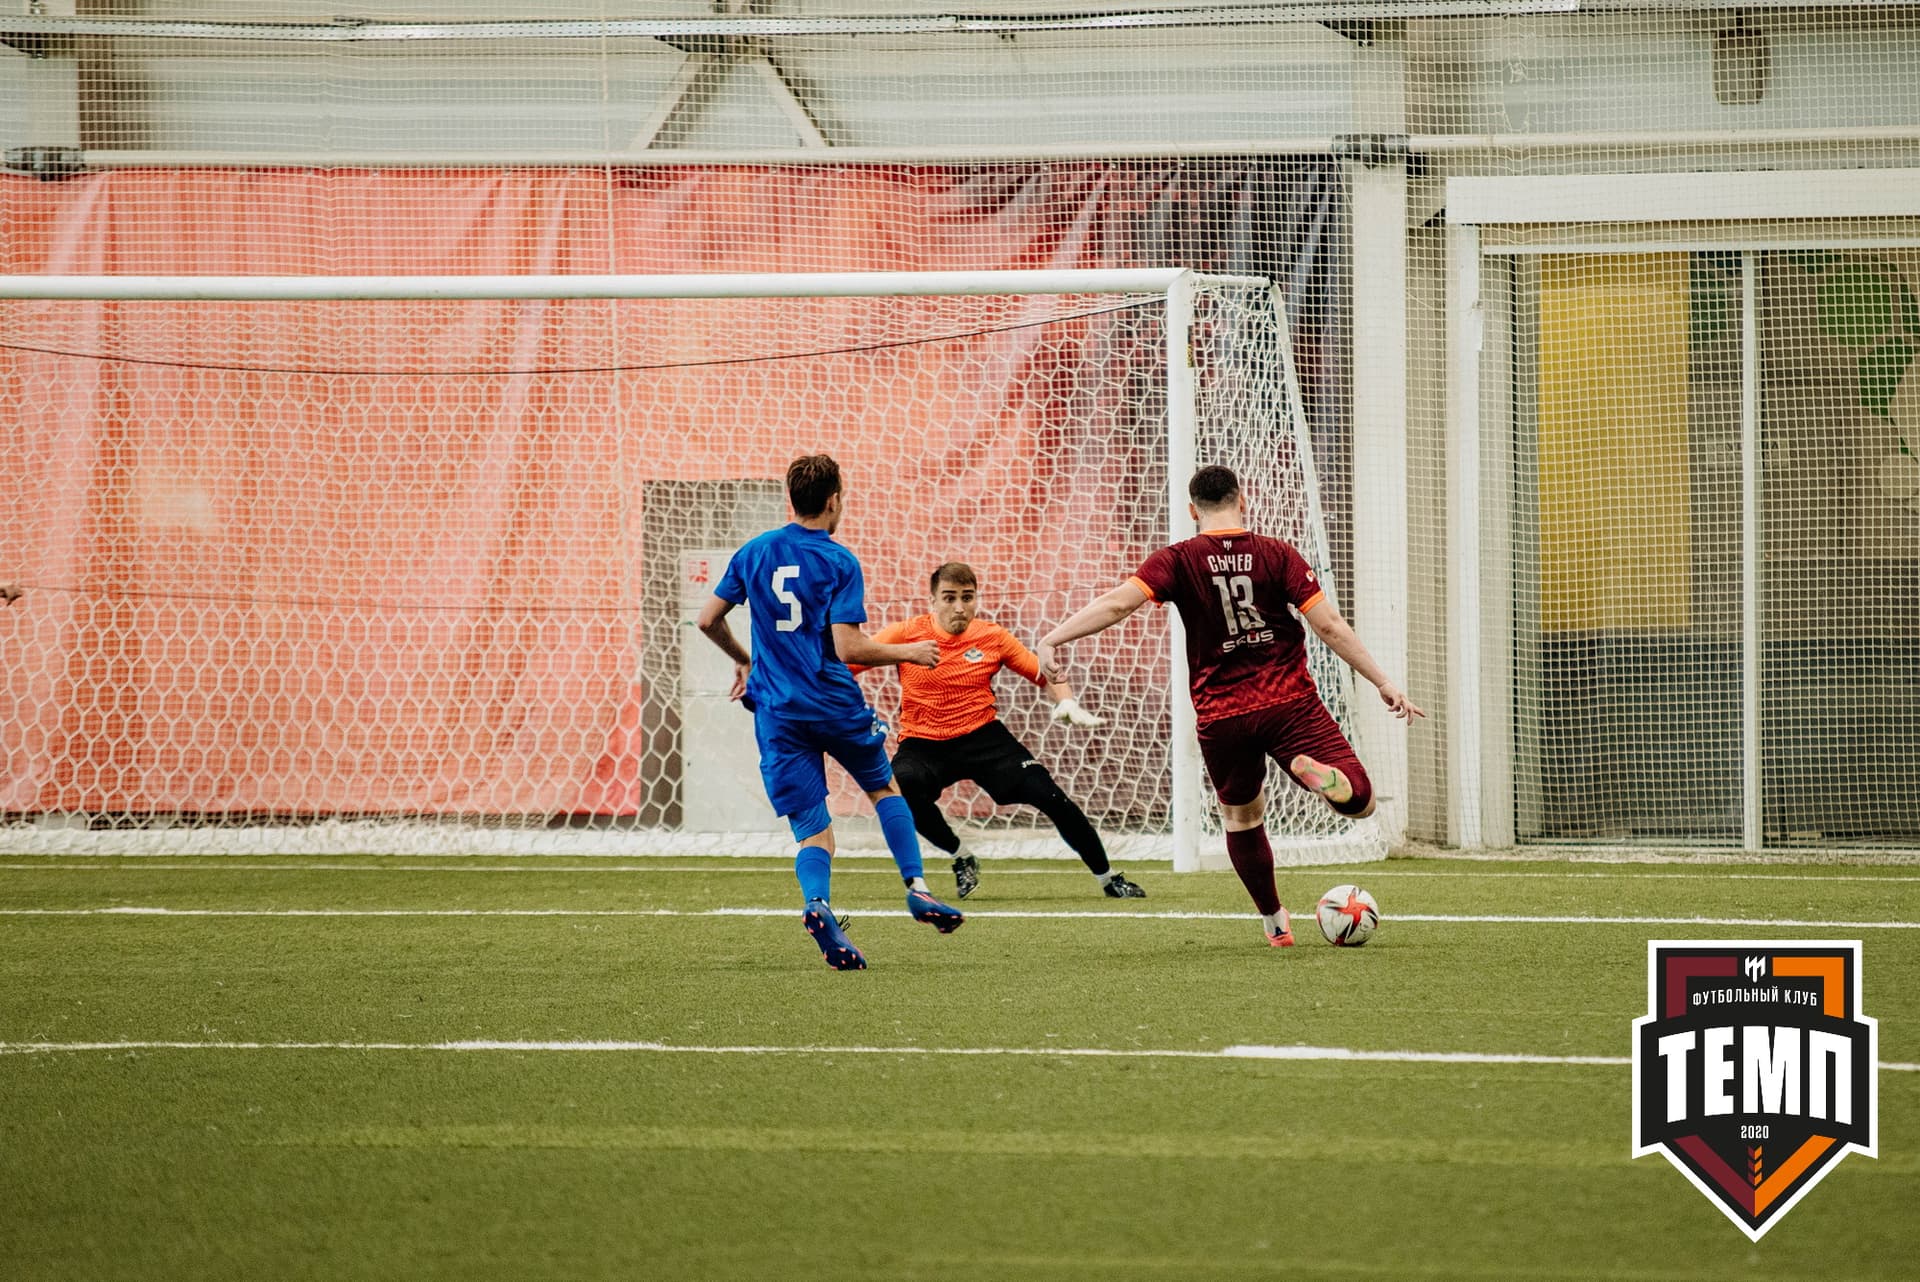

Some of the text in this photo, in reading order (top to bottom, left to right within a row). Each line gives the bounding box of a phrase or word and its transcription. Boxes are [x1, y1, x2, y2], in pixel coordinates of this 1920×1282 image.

[1207, 553, 1253, 573] СЫЧЕВ
[771, 565, 804, 633] 5
[1211, 575, 1266, 636] 13
